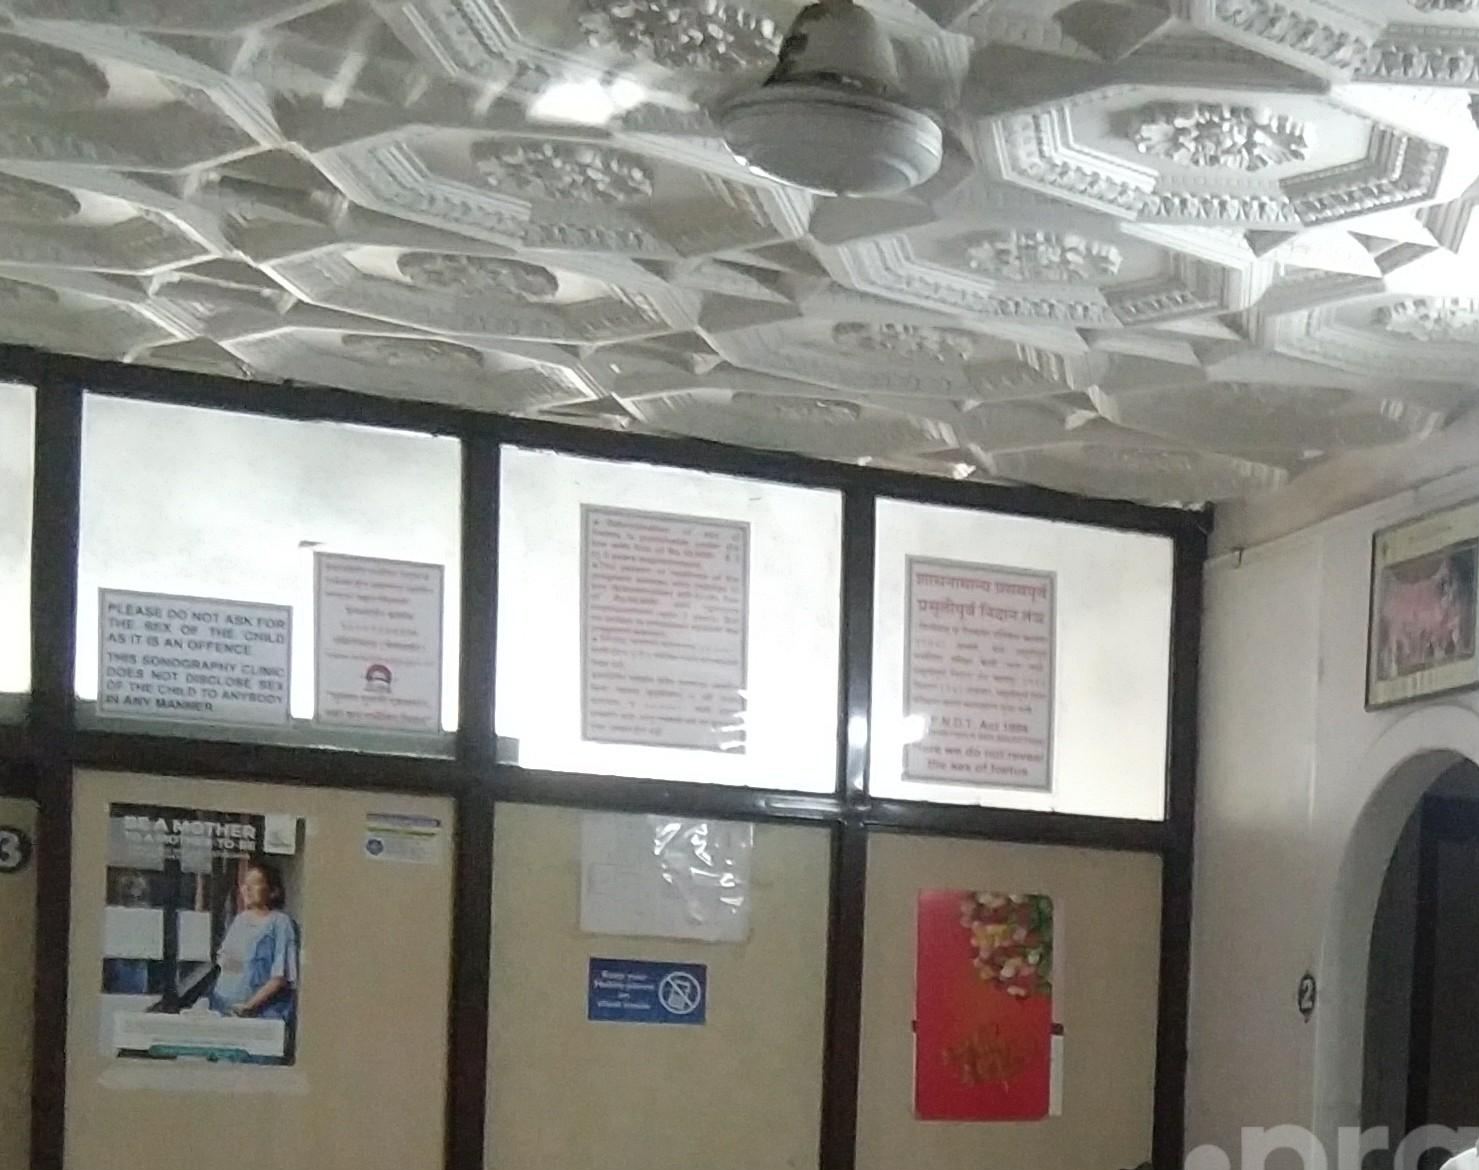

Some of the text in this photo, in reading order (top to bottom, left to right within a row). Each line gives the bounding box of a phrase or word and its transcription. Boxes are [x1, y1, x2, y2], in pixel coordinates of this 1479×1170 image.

[107, 603, 286, 629] PLEASE DO NOT ASK FOR
[108, 617, 285, 644] THE SEX OF THE CHILD
[108, 632, 126, 644] AS
[130, 634, 142, 645] IT
[145, 635, 159, 647] IS
[163, 638, 183, 649] AN
[107, 651, 285, 677] THIS SONOGRAPHY CLINIC
[106, 666, 283, 692] DOES NOT DISCLOSE SEX
[106, 680, 282, 704] OF THE CHILD TO ANYBODY
[105, 695, 213, 712] IN ANY MANNER
[153, 817, 169, 832] A
[173, 819, 257, 840] MOTHER
[0, 831, 21, 867] 3
